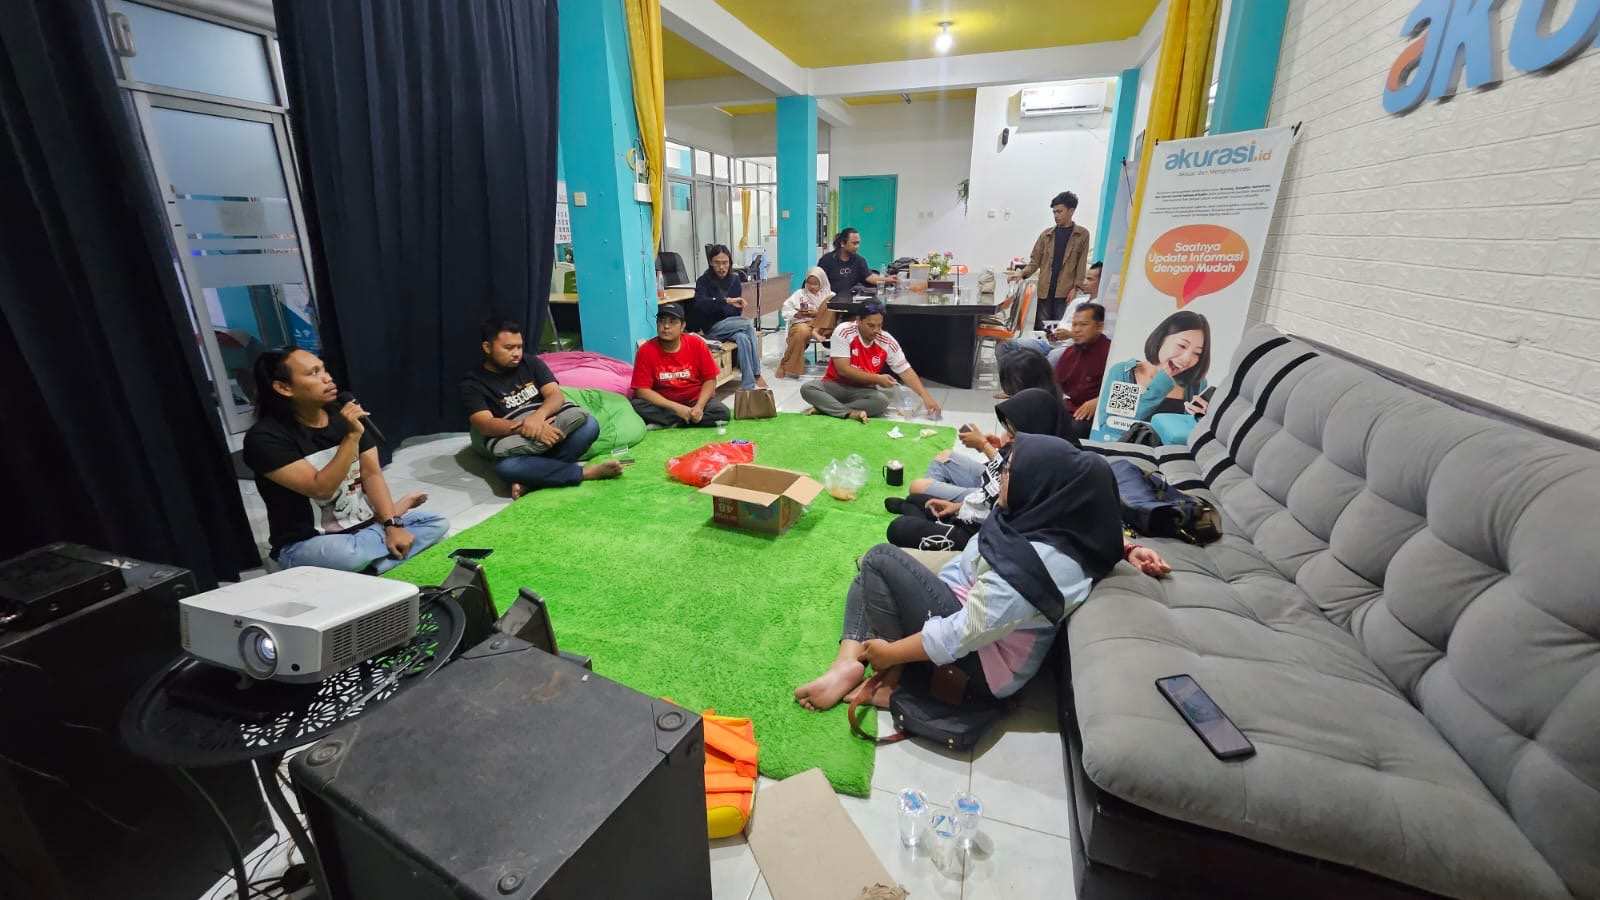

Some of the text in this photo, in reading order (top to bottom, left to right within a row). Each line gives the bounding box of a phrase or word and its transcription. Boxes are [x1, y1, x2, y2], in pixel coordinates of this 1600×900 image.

[1382, 0, 1600, 113] aku
[1174, 242, 1222, 253] Saatnya
[1149, 252, 1244, 263] Update Informasi
[1153, 263, 1236, 275] dengan Mudah
